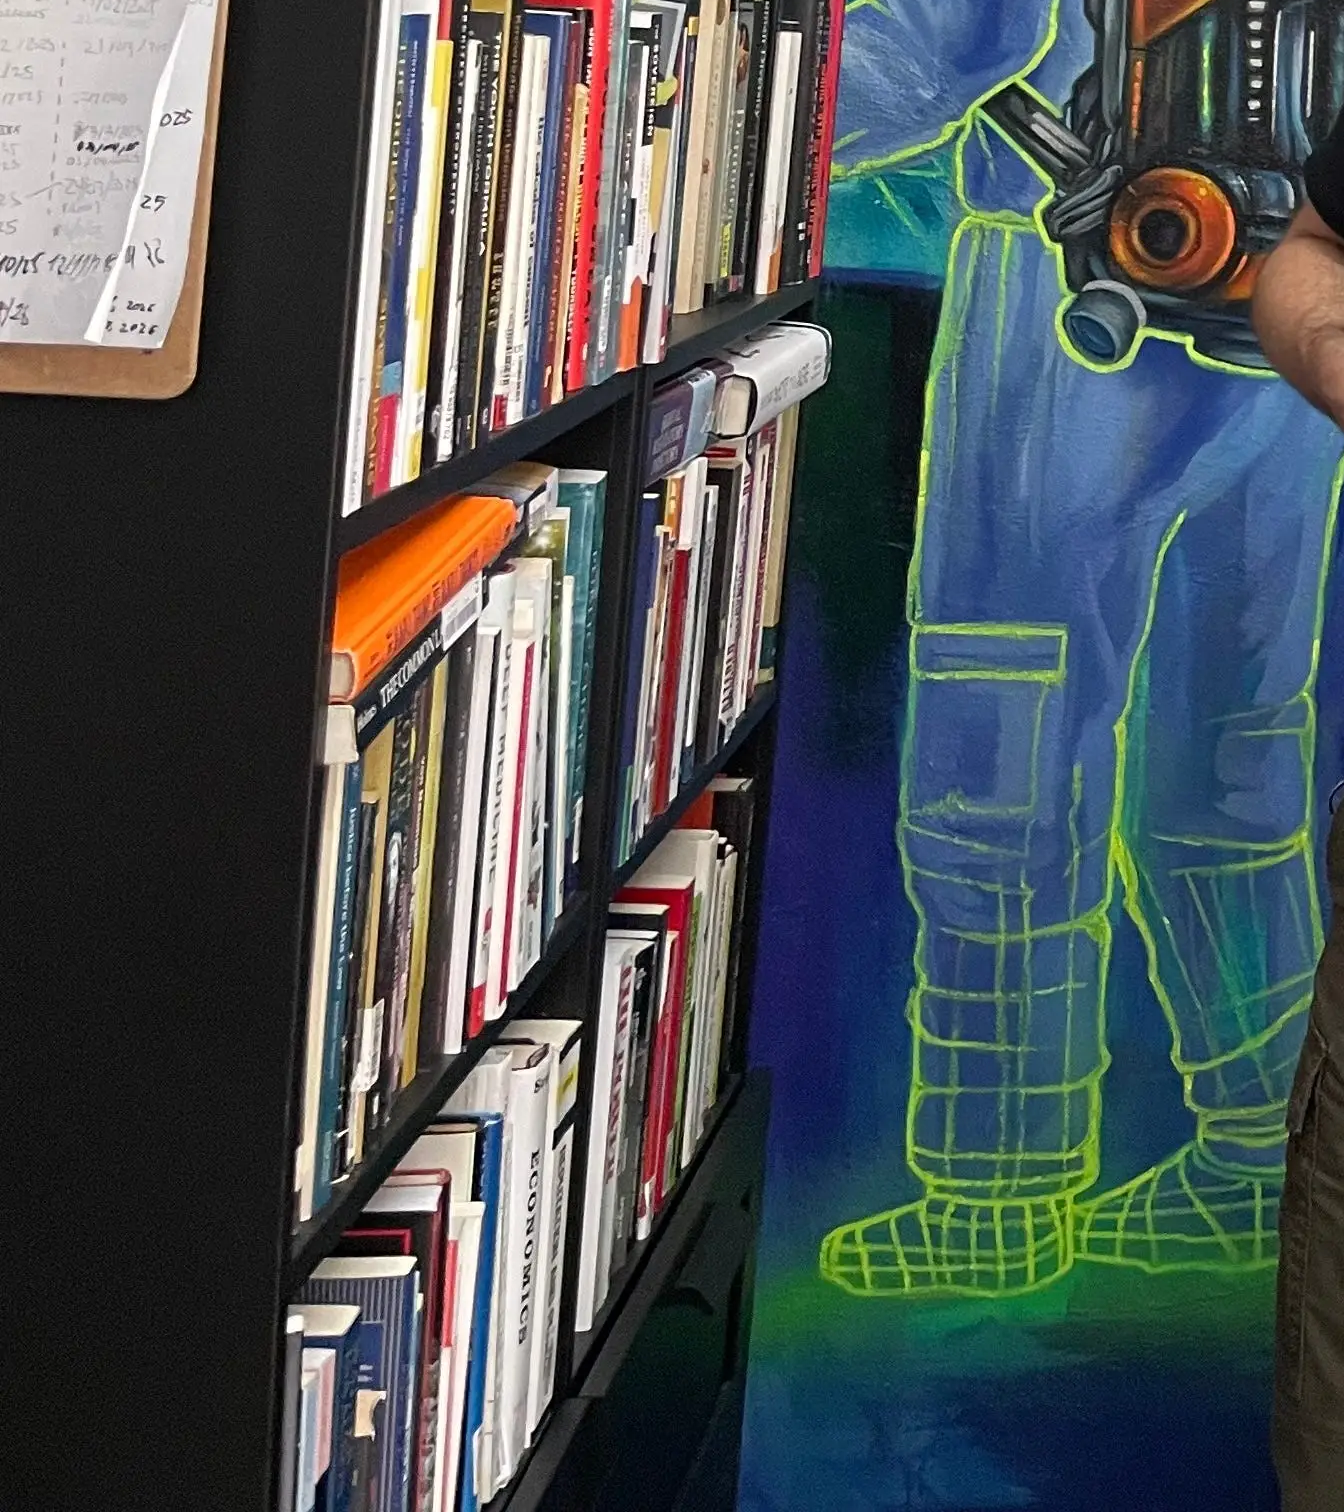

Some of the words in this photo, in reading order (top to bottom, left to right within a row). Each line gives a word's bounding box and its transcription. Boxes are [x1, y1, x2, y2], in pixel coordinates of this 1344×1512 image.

[493, 31, 503, 72] THE
[487, 77, 499, 147] YOUTH
[647, 44, 660, 138] SOVEREIGN
[479, 152, 495, 256] FORMULA
[499, 643, 512, 722] DEEP
[347, 806, 358, 862] Justice
[489, 734, 507, 884] MEDICINE
[343, 865, 354, 921] before
[340, 924, 349, 953] the
[518, 1148, 541, 1345] ECONOMICS
